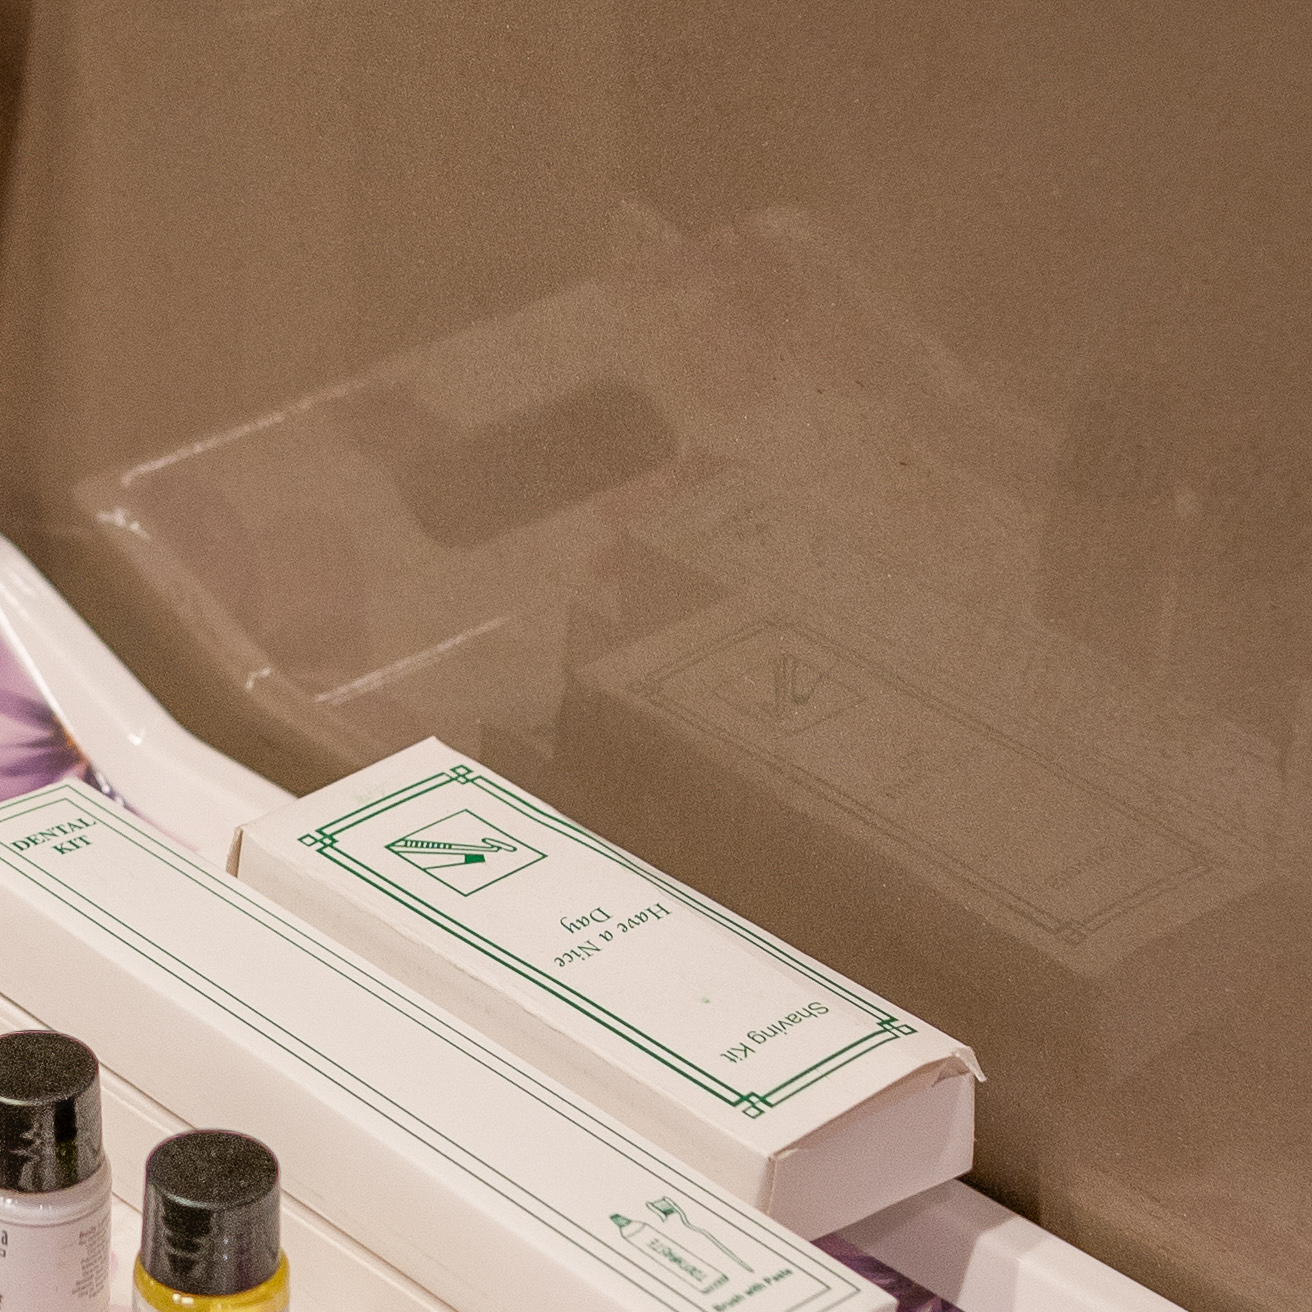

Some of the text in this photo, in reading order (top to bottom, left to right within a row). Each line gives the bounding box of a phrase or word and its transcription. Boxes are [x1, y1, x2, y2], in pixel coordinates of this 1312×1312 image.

[11, 818, 97, 851] DENTAL
[51, 835, 92, 855] KIT
[554, 902, 672, 967] Have a Nice
[560, 906, 613, 934] Day
[720, 1001, 829, 1064] Shaving Kit
